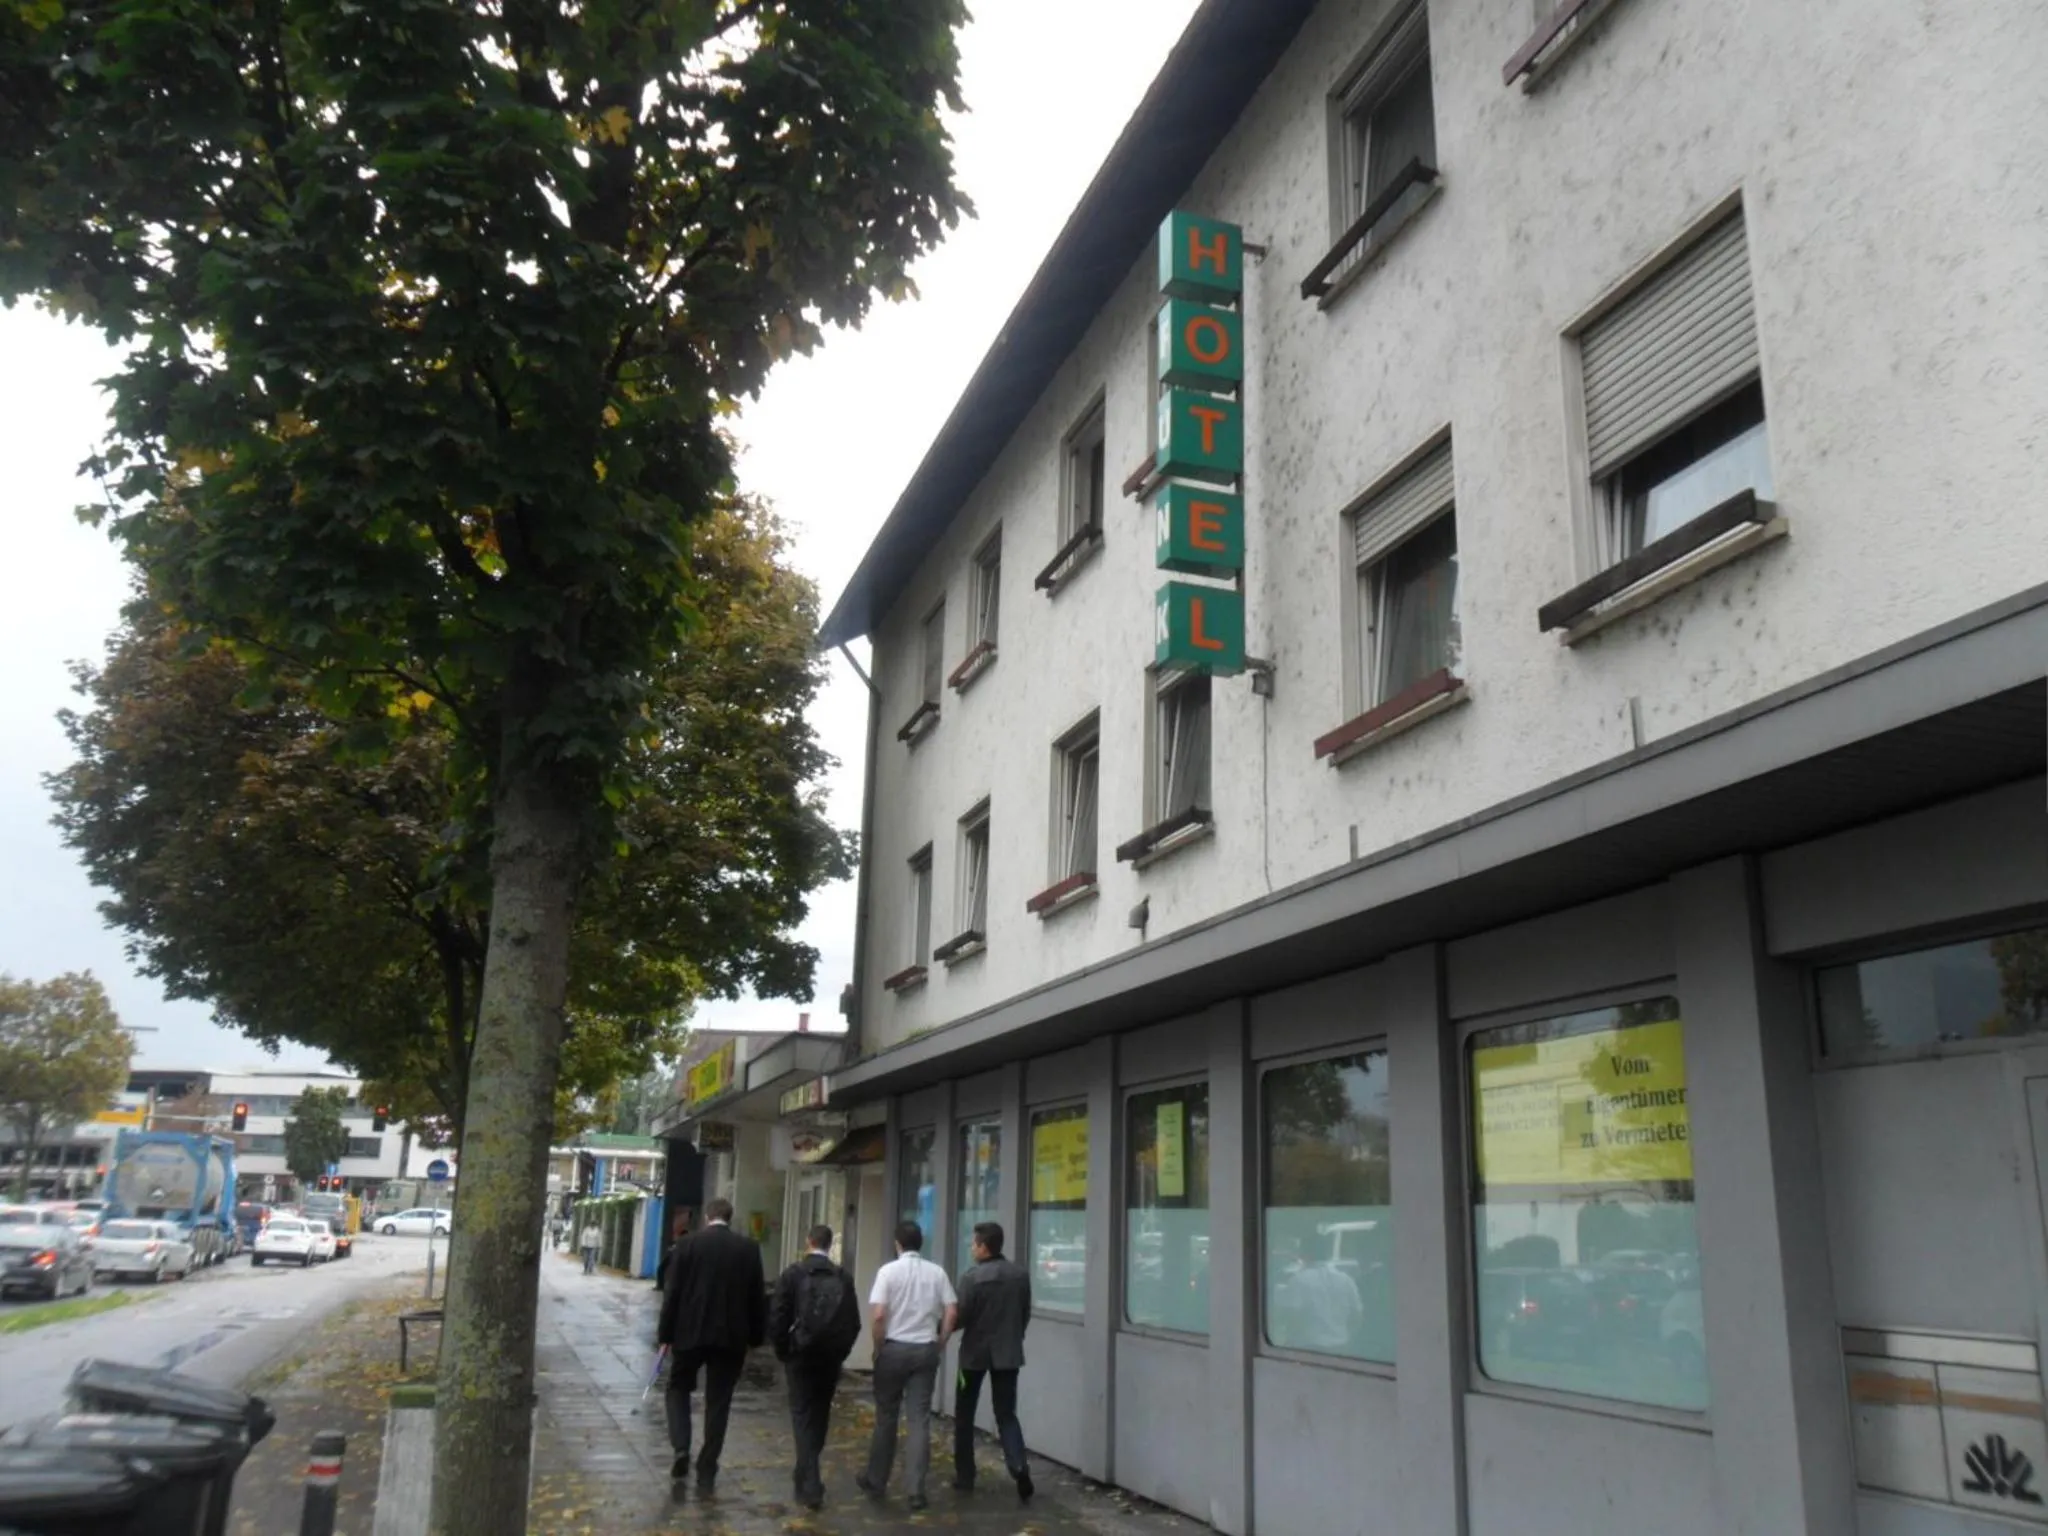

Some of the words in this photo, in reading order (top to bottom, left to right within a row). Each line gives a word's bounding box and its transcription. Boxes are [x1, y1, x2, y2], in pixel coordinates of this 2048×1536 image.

[1184, 225, 1230, 652] HOTEL
[1156, 319, 1171, 646] FUNK
[1611, 1056, 1649, 1077] Vom
[1585, 1086, 1688, 1116] Eigentümer
[1581, 1132, 1598, 1148] zu
